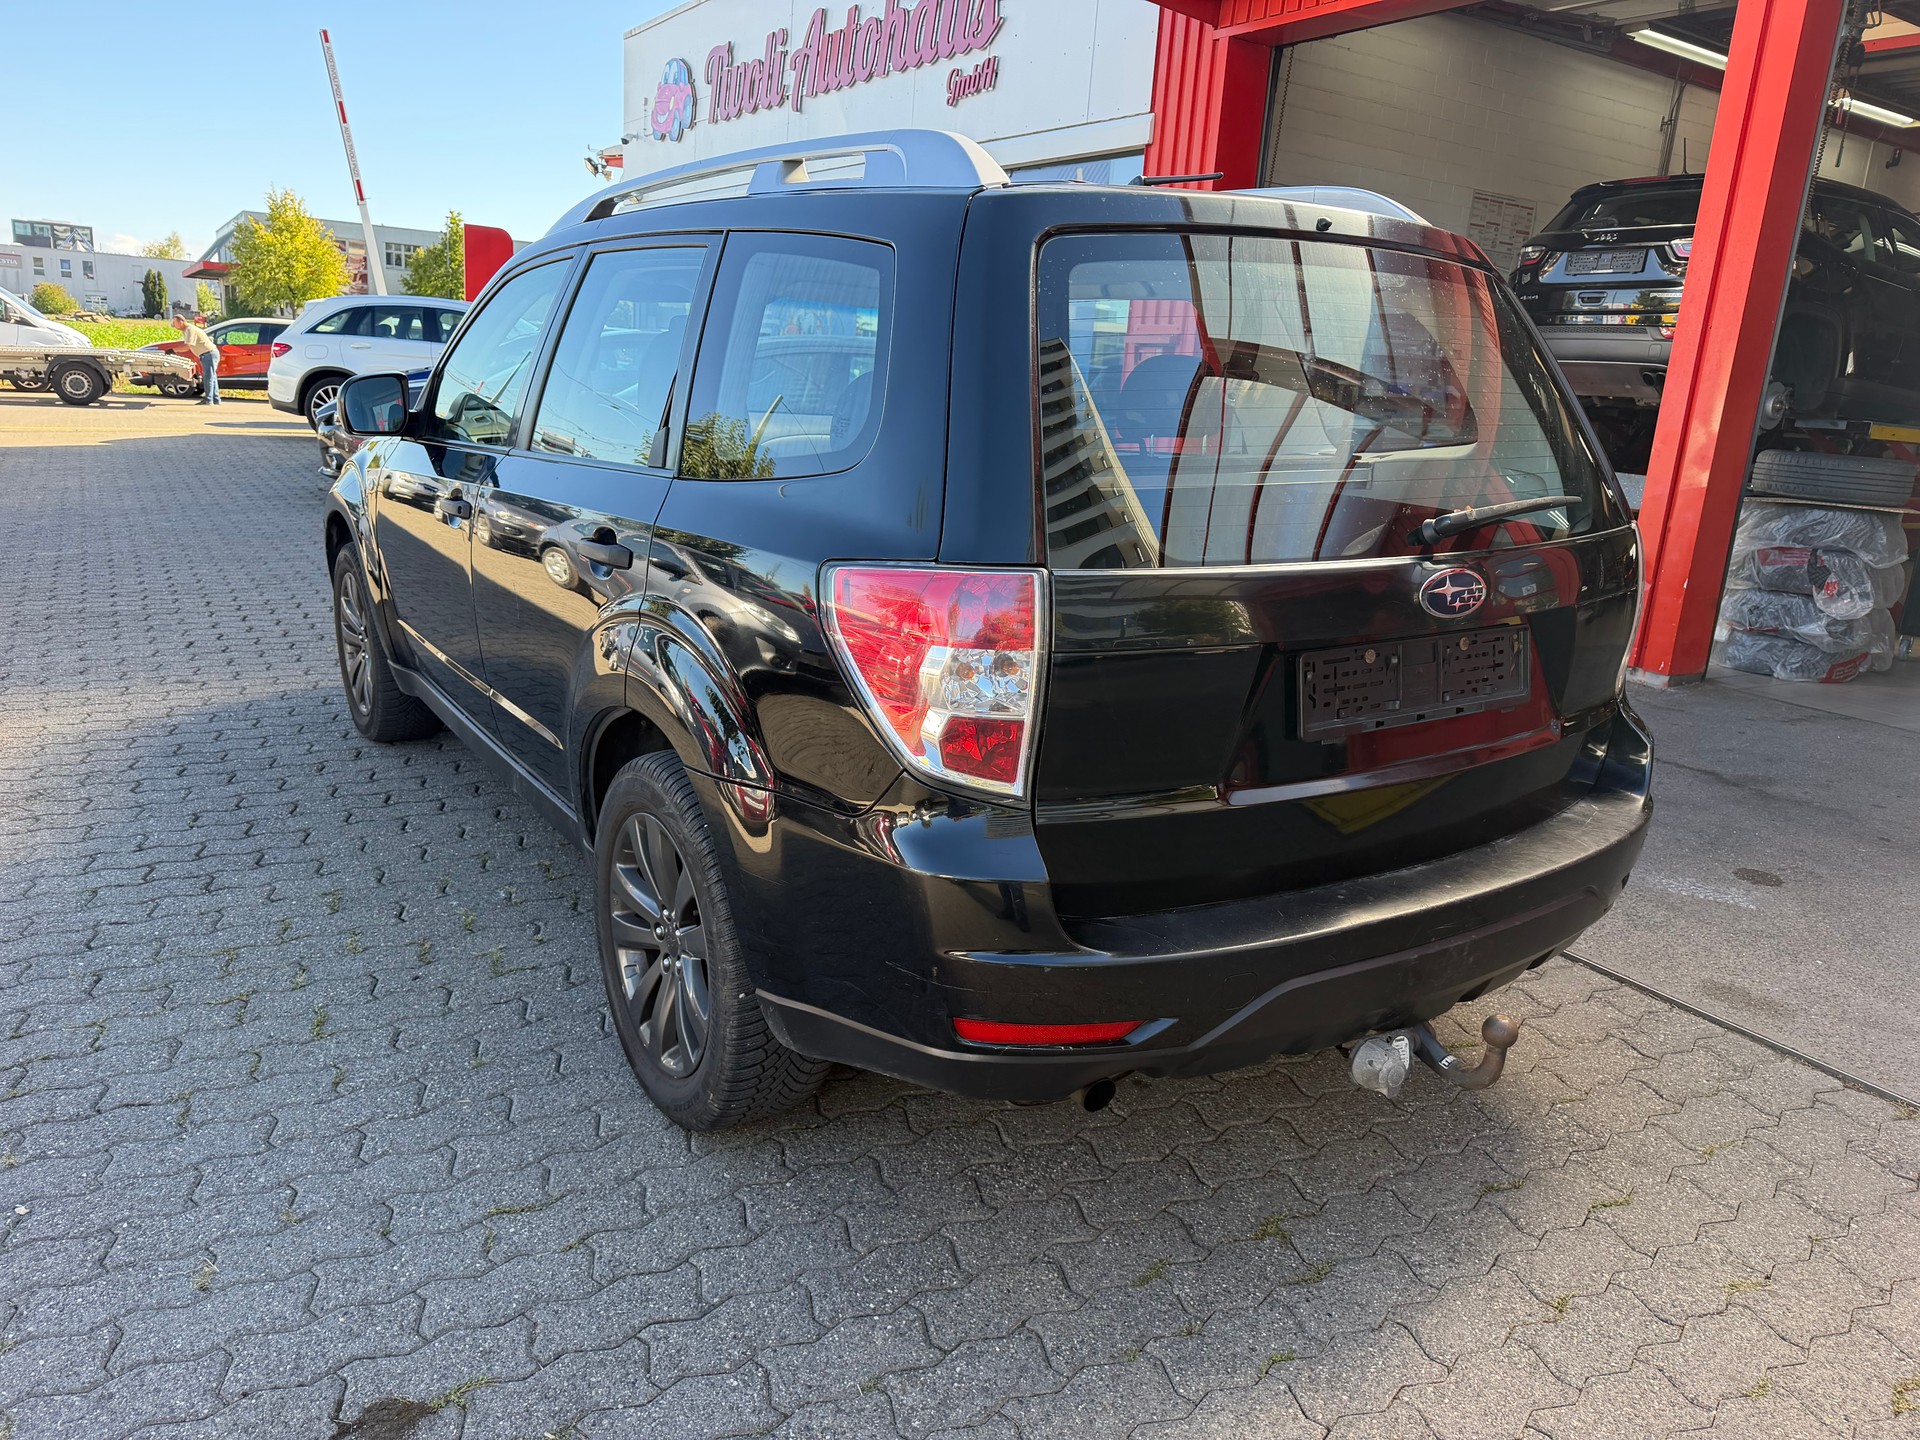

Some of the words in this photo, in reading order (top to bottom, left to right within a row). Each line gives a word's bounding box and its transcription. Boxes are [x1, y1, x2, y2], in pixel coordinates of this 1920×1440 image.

[704, 28, 788, 124] Tivoli
[790, 0, 1006, 113] Autohaus
[946, 55, 999, 107] GmbH
